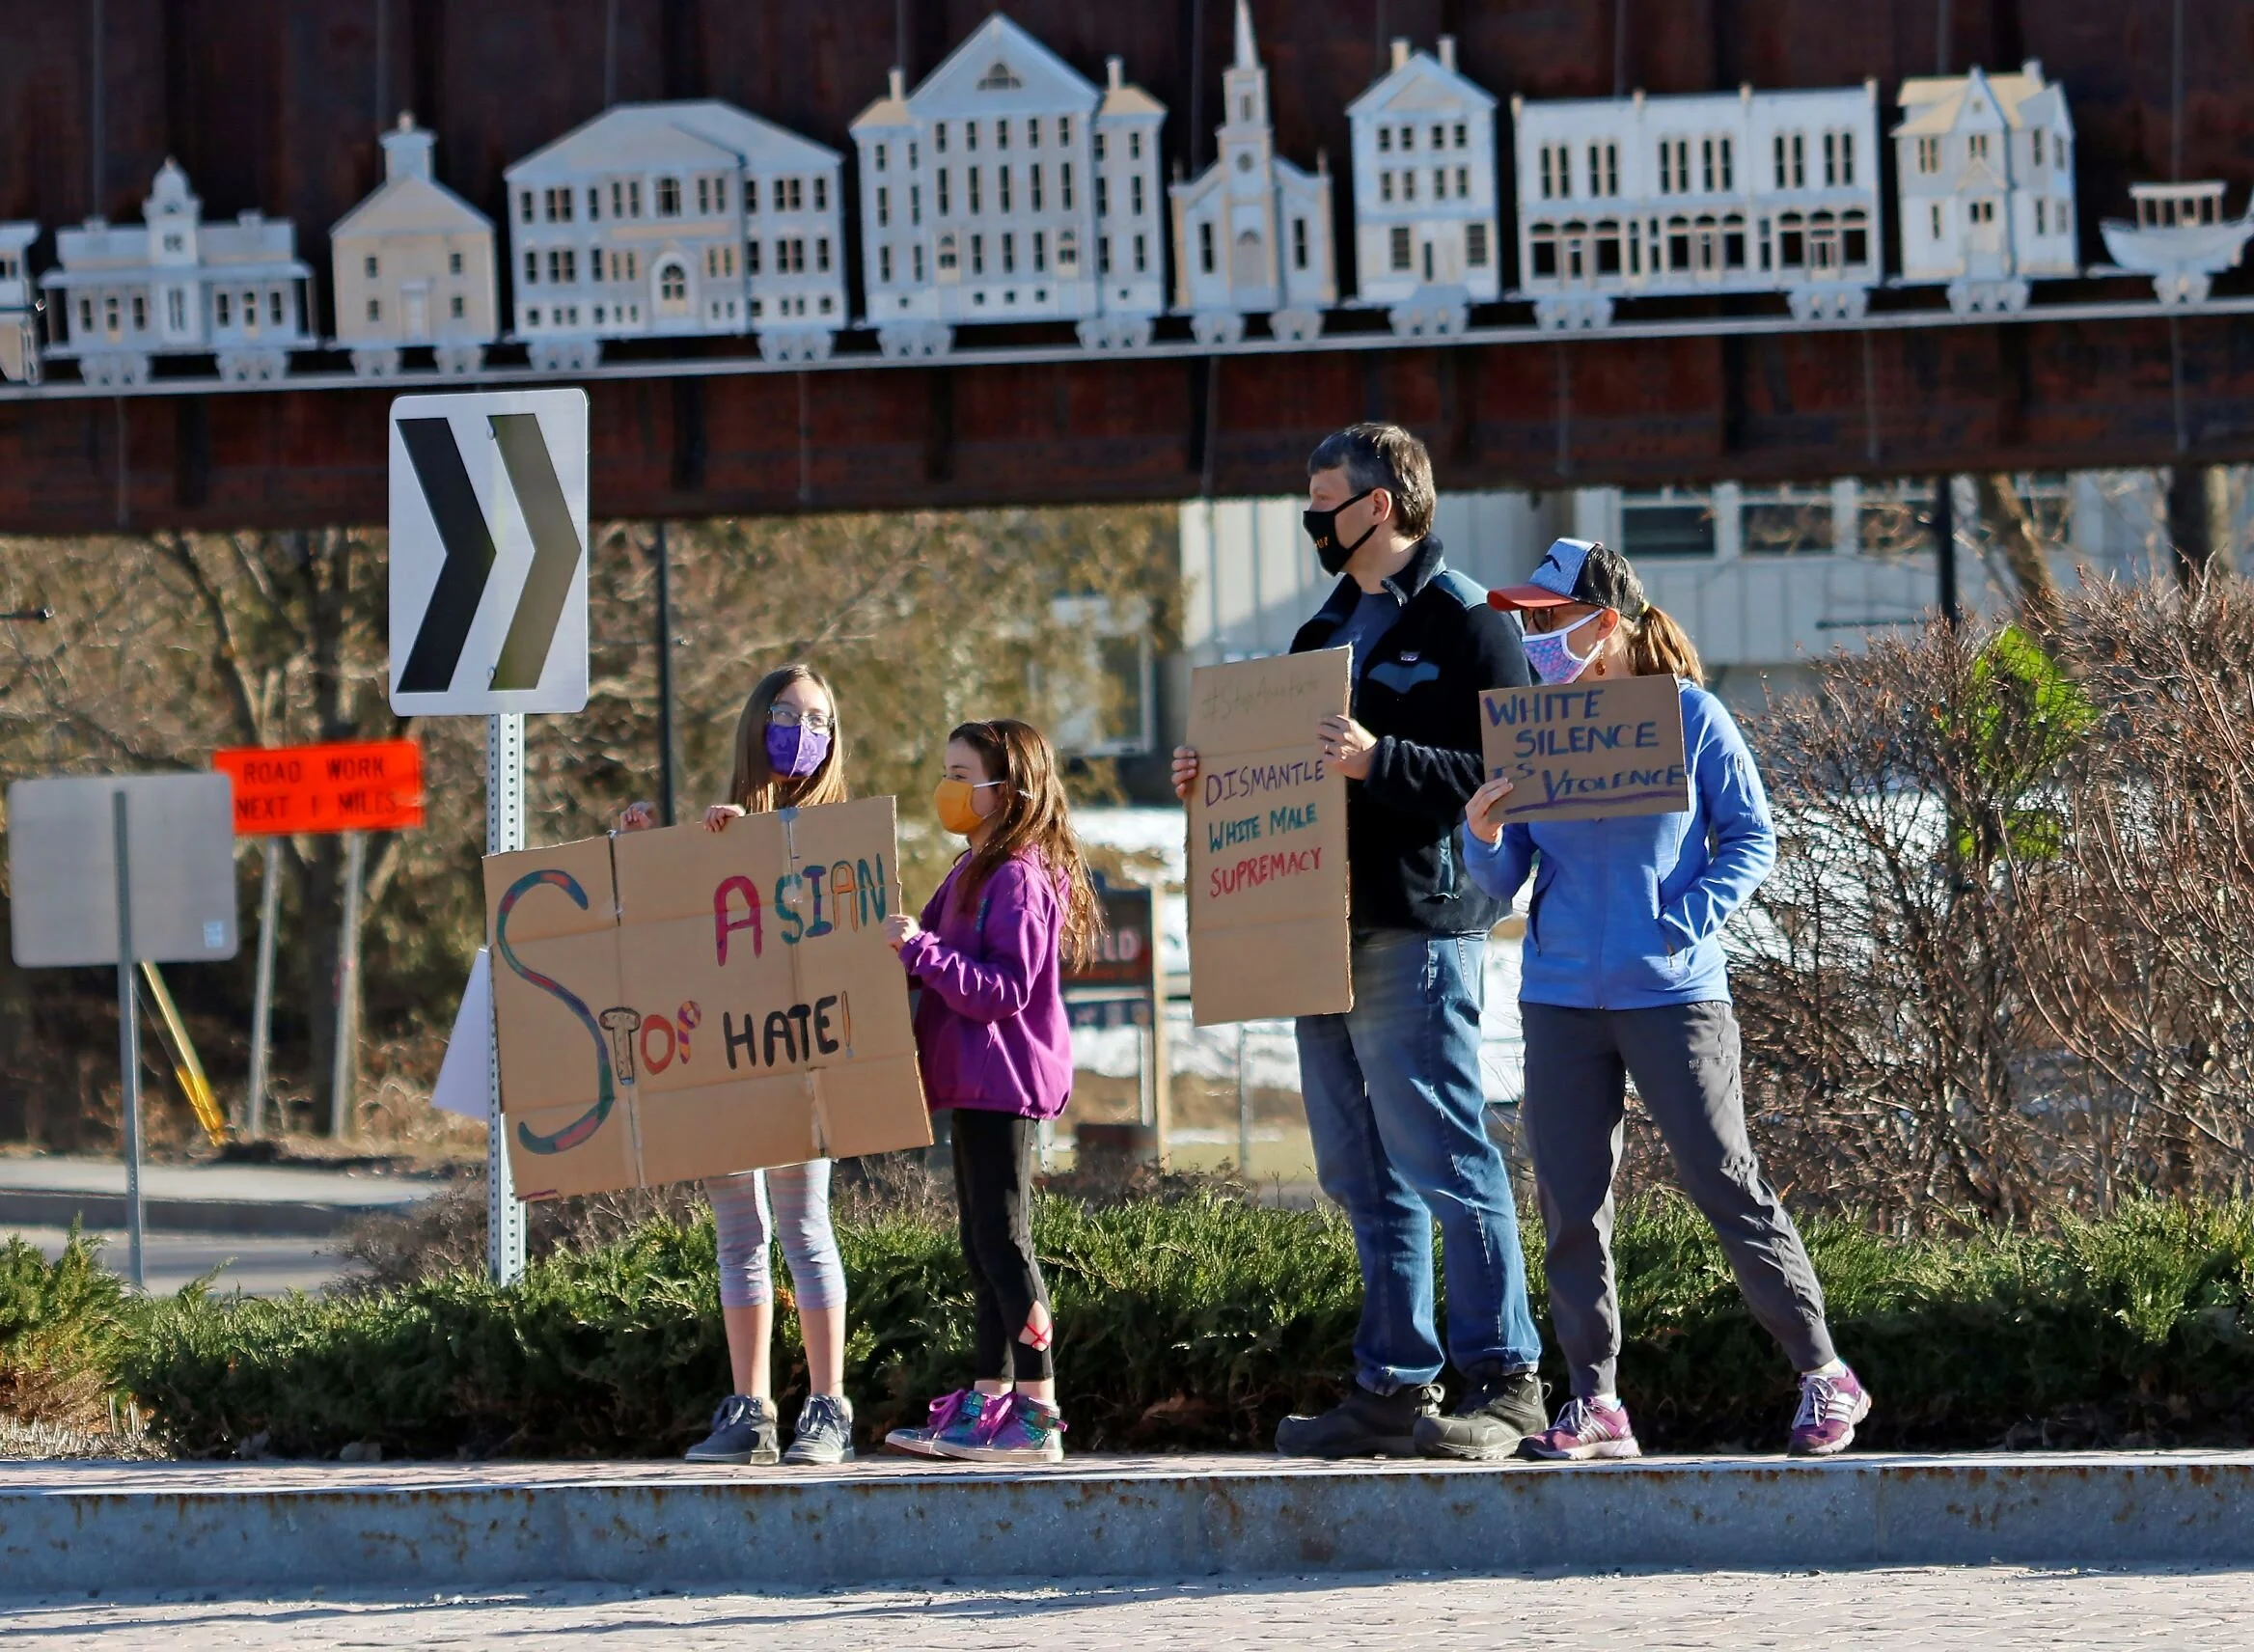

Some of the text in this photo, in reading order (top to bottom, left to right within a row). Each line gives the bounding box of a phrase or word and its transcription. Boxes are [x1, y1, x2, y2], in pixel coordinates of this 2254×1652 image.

[1483, 689, 1605, 727] WHITE
[1513, 722, 1659, 758] SILENCE
[243, 757, 384, 785] ROAD WORK
[1205, 759, 1325, 808] DISMANTLE
[1491, 760, 1687, 802] IS VIOLENCE
[236, 795, 289, 819] NEXT
[339, 788, 398, 814] MILES
[1208, 802, 1317, 853] WHITE MALE
[1210, 846, 1322, 898] SUPREMACY
[714, 853, 886, 966] ASIAN
[497, 869, 854, 1154] STOP HATE!
